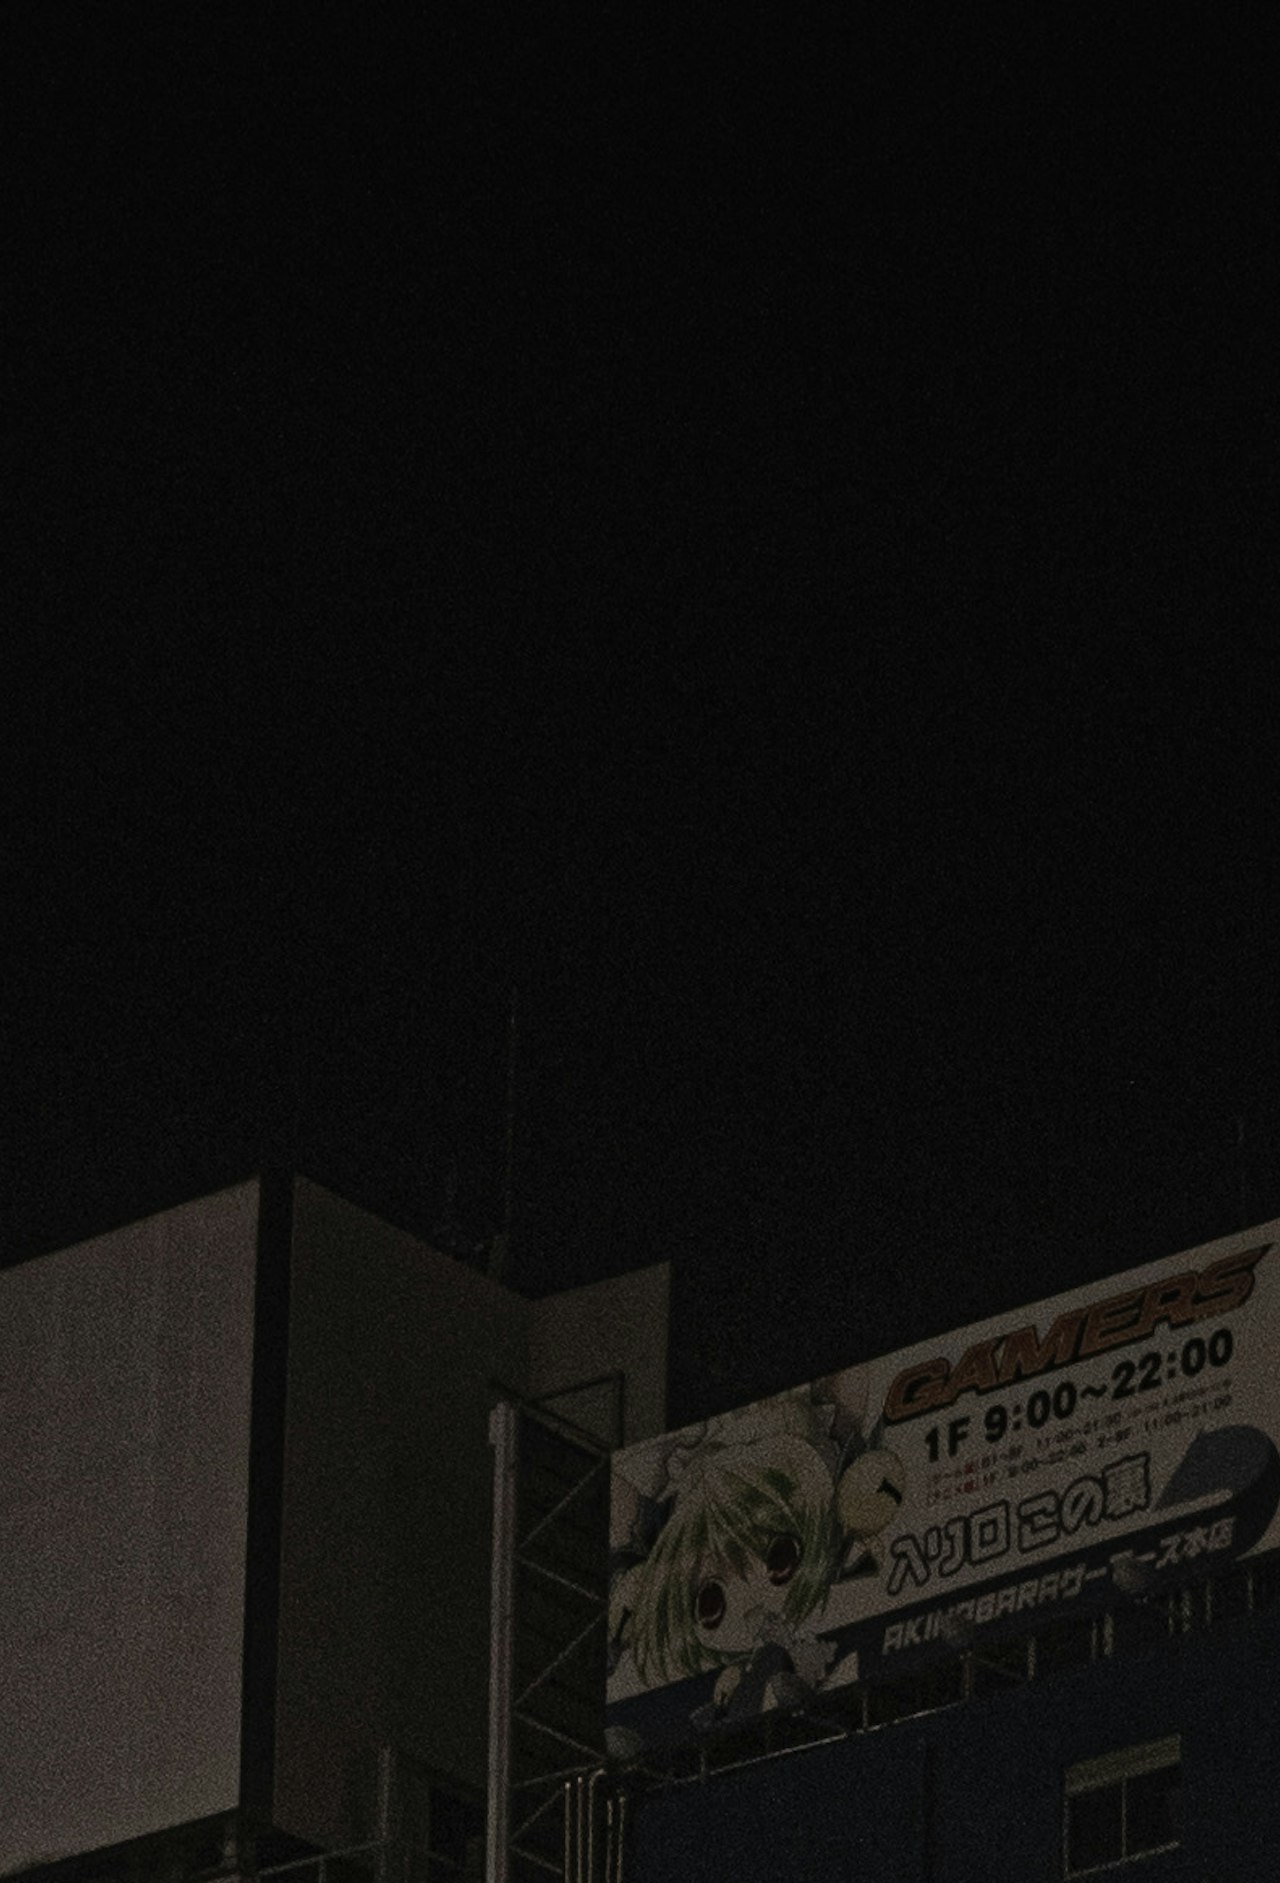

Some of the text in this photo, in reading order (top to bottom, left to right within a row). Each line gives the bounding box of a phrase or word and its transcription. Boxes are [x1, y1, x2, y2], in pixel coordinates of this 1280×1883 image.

[884, 1244, 1273, 1425] GAMERS
[925, 1416, 971, 1463] 1F
[984, 1329, 1234, 1443] 9:00~22:00
